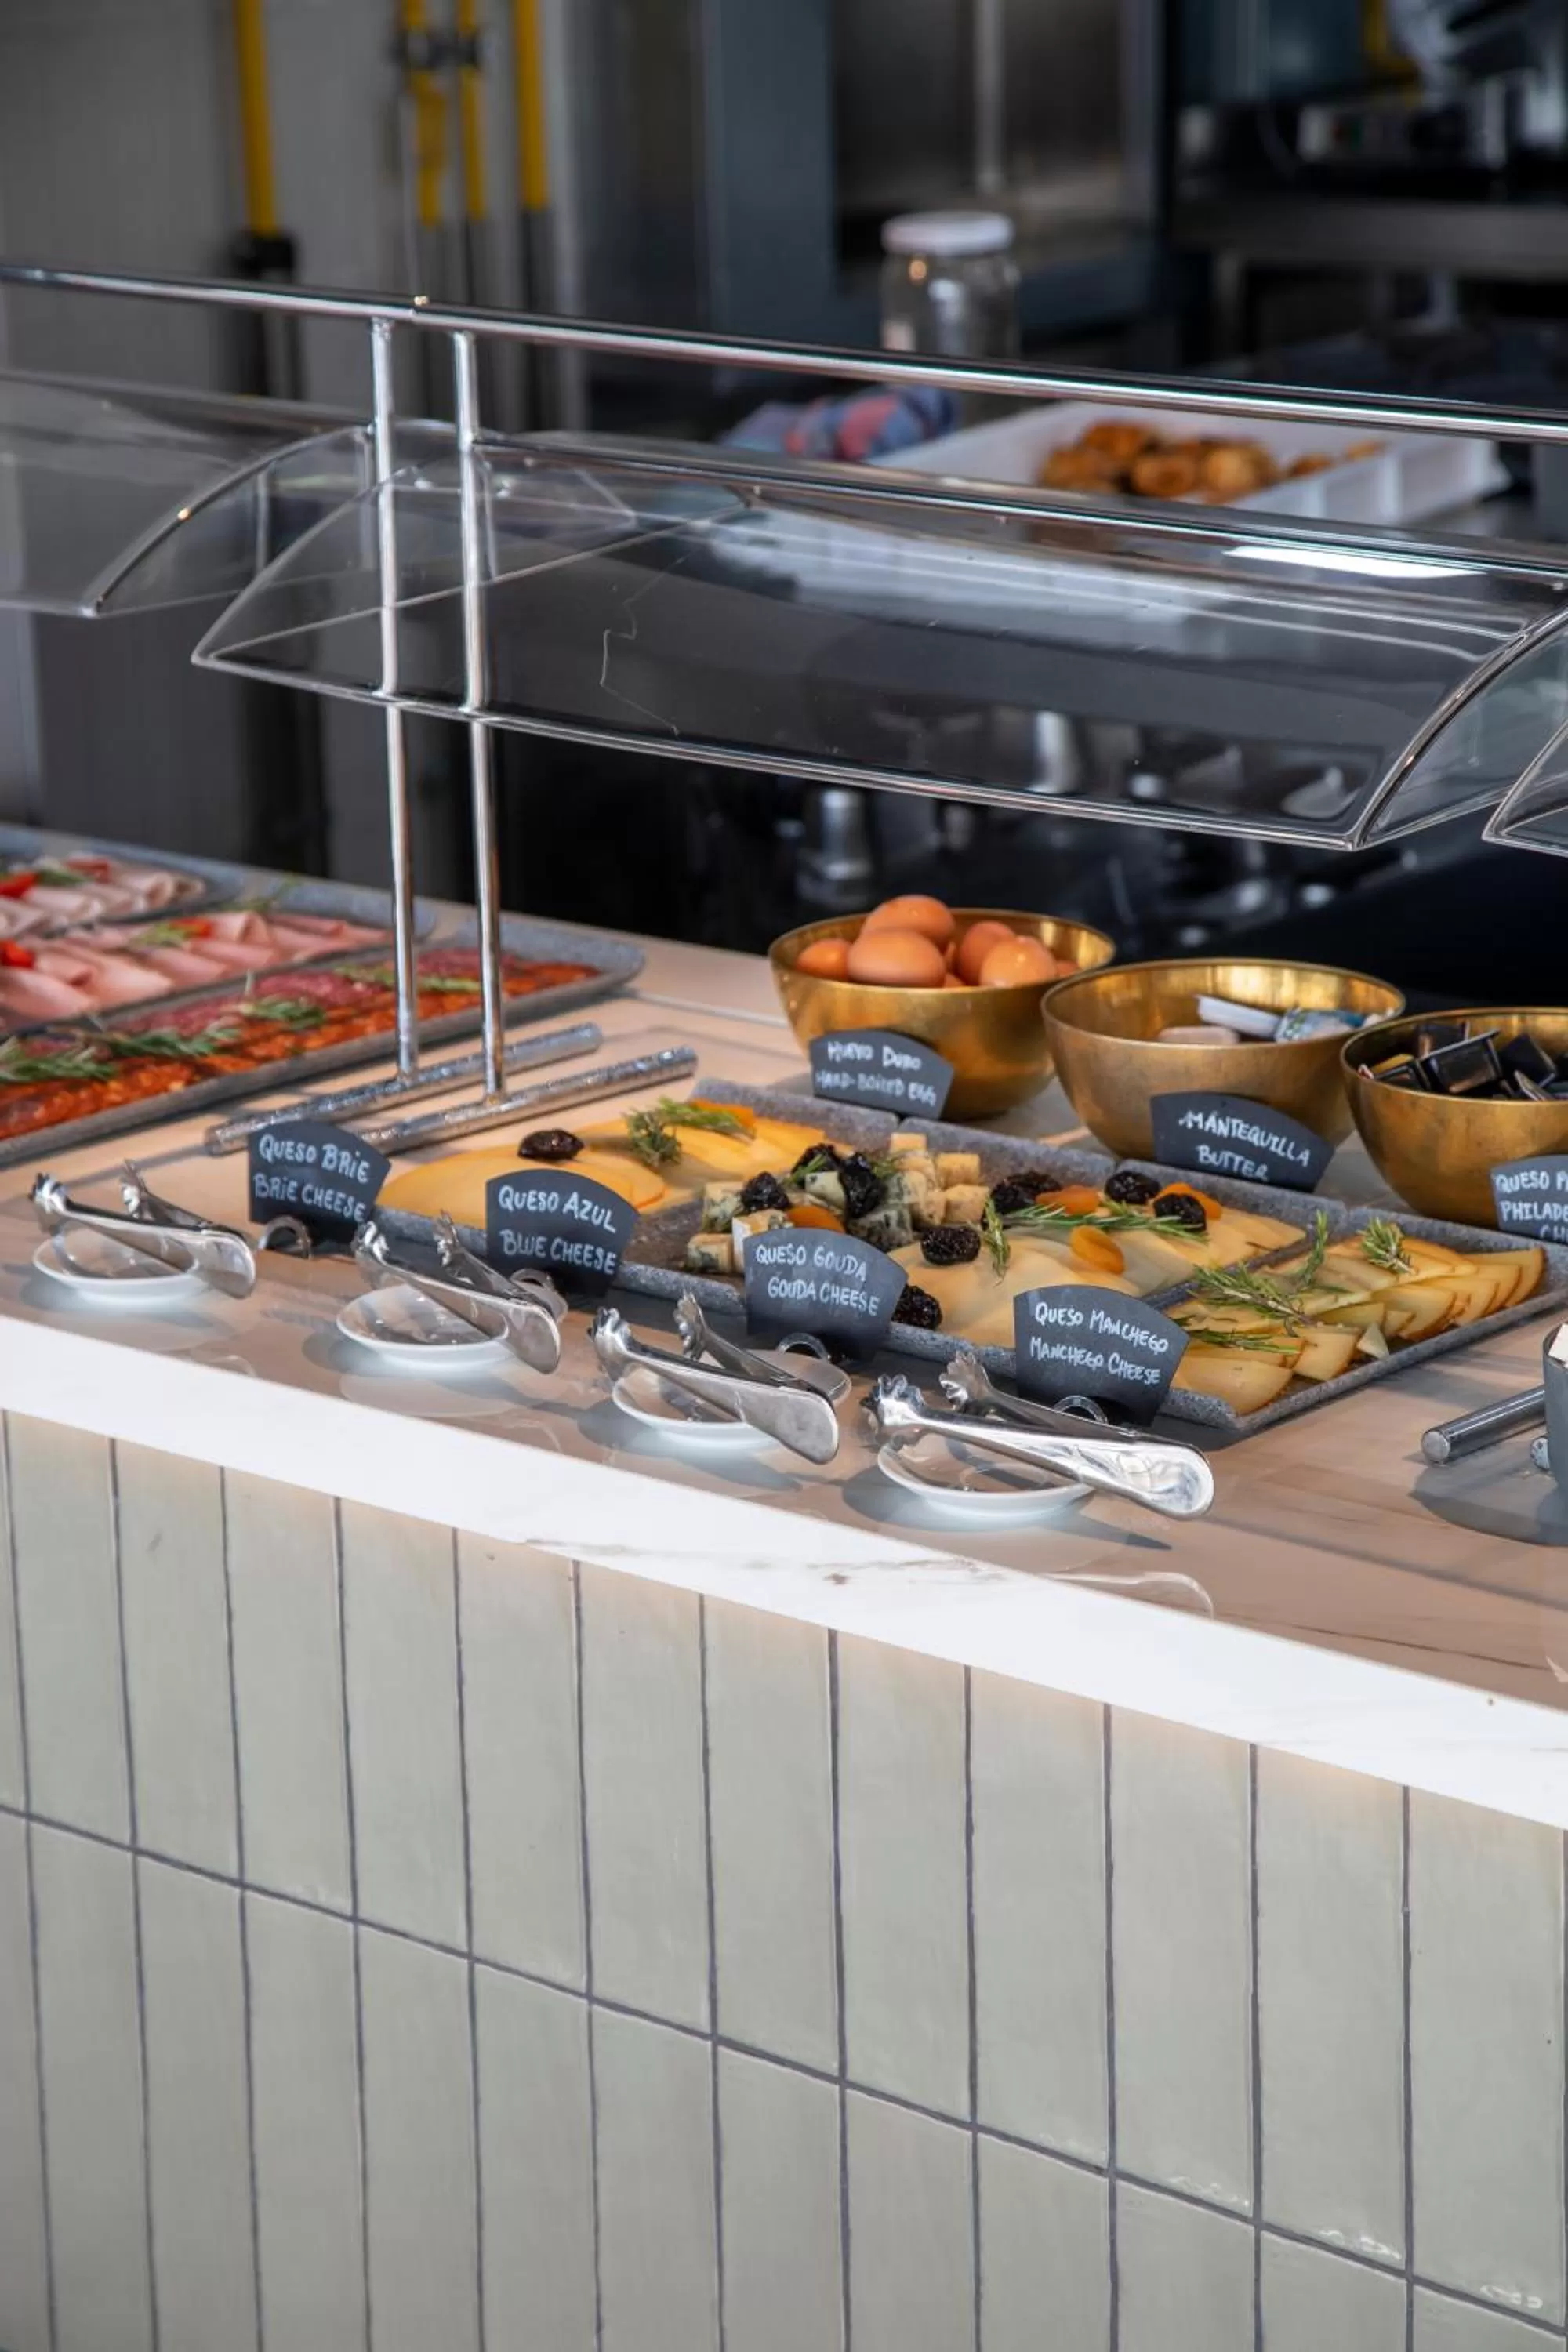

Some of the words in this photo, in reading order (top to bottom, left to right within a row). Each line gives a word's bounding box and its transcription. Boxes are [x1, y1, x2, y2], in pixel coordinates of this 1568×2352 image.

[258, 1133, 318, 1163] QUESO
[1196, 1143, 1269, 1182] BUTTER
[1495, 1169, 1551, 1194] QUESO
[300, 1183, 367, 1223] CHEESE
[498, 1185, 560, 1212] QUESO
[561, 1191, 617, 1234] AZUL
[498, 1228, 548, 1258] BLUE
[550, 1236, 618, 1276] CHEESE
[755, 1243, 807, 1265] QUESO
[813, 1245, 867, 1282] GOUDA
[767, 1276, 816, 1301] GOUDA
[819, 1282, 881, 1317] CHEESE
[1034, 1301, 1084, 1327] QUESO
[1088, 1308, 1170, 1356] MANCHEGO
[1029, 1335, 1105, 1371] MANCHEGO
[1107, 1352, 1162, 1385] CHEESE
